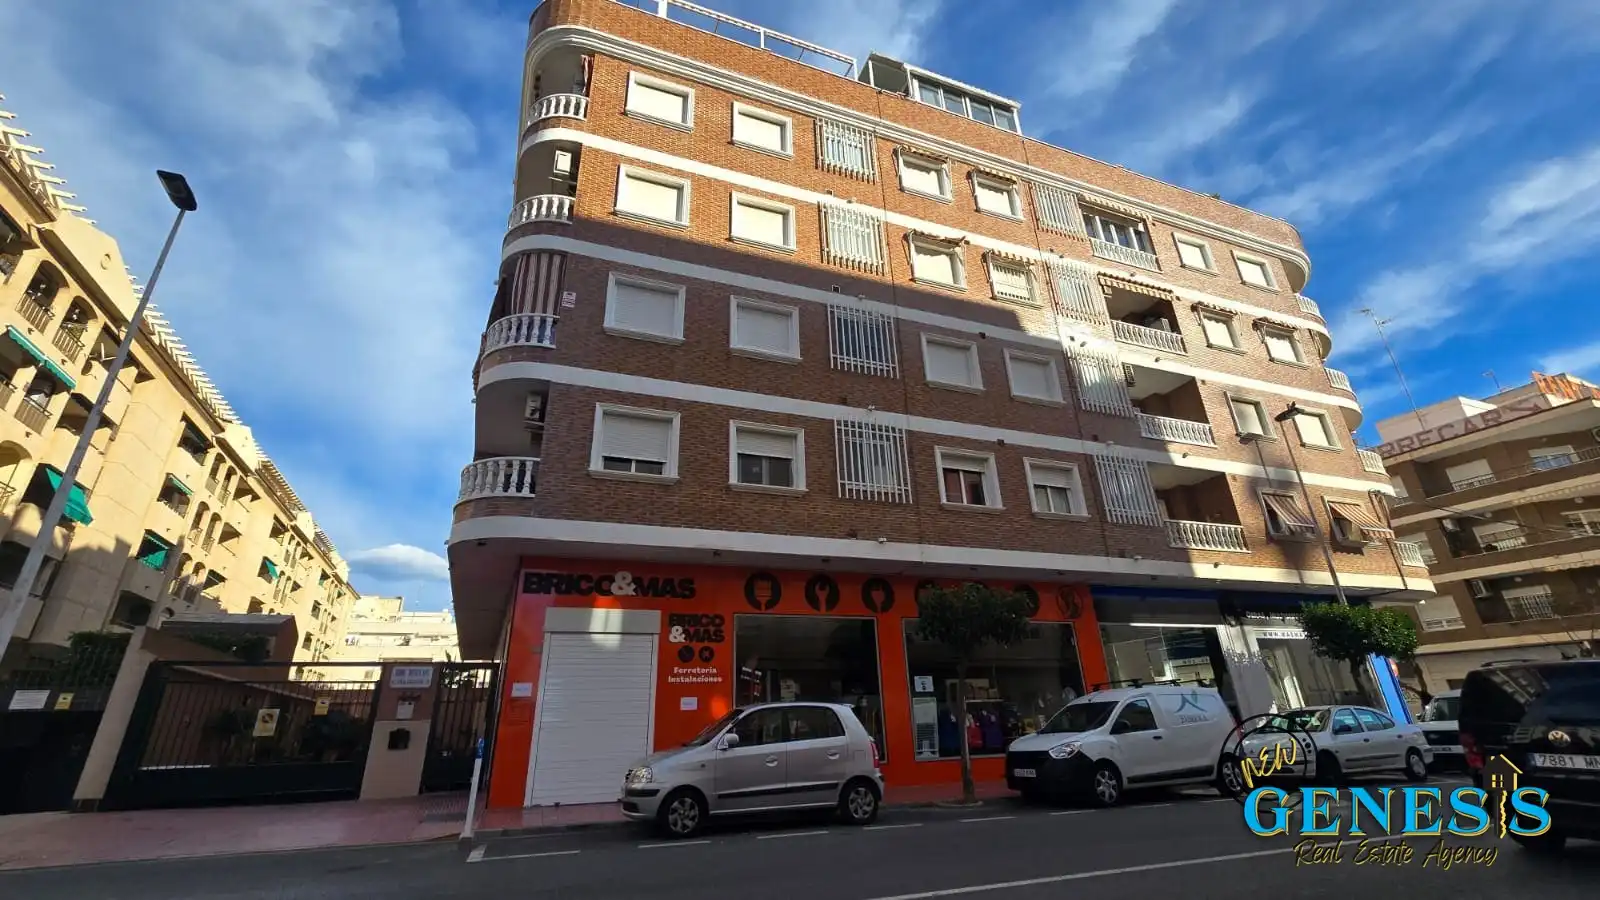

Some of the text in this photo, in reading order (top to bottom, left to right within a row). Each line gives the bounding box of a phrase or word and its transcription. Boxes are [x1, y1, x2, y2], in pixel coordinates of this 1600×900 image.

[668, 613, 725, 628] BRICO
[668, 625, 725, 643] &MAS
[667, 675, 722, 684] Instalaciones
